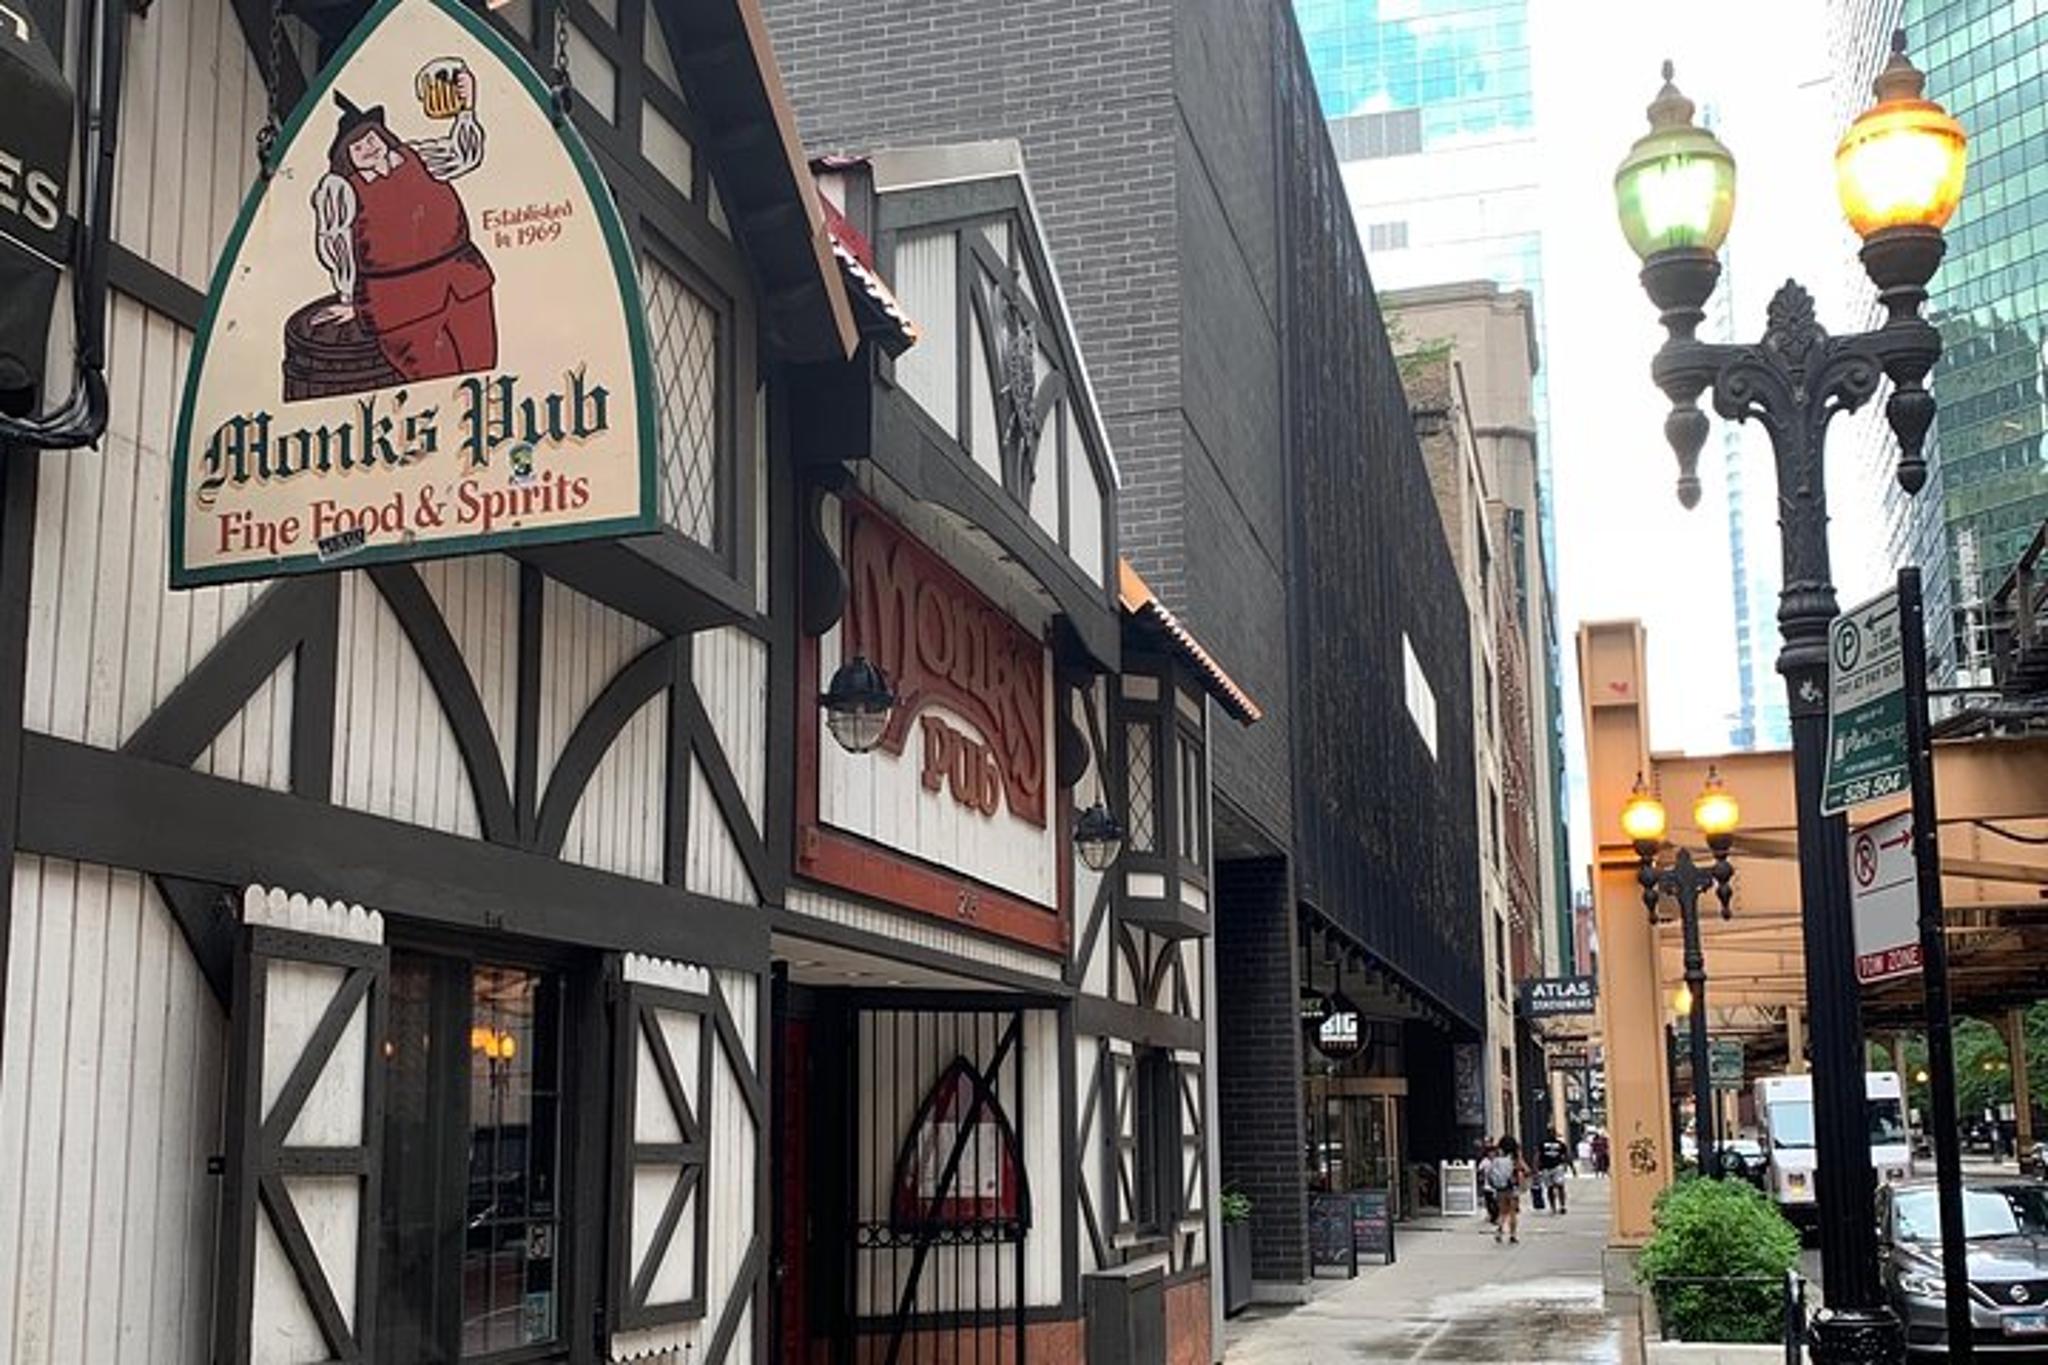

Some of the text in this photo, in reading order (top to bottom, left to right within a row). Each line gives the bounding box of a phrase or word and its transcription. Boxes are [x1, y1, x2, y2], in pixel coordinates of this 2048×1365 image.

[482, 199, 573, 231] Established
[517, 222, 562, 245] 1969
[200, 363, 611, 506] Monk's Pub
[217, 511, 300, 555] Fine
[309, 493, 405, 543] Food
[415, 485, 447, 528] &
[457, 470, 591, 531] Spirits
[1887, 945, 1920, 971] ZONE
[1532, 981, 1591, 998] ATLAS
[1320, 1011, 1358, 1034] BIG
